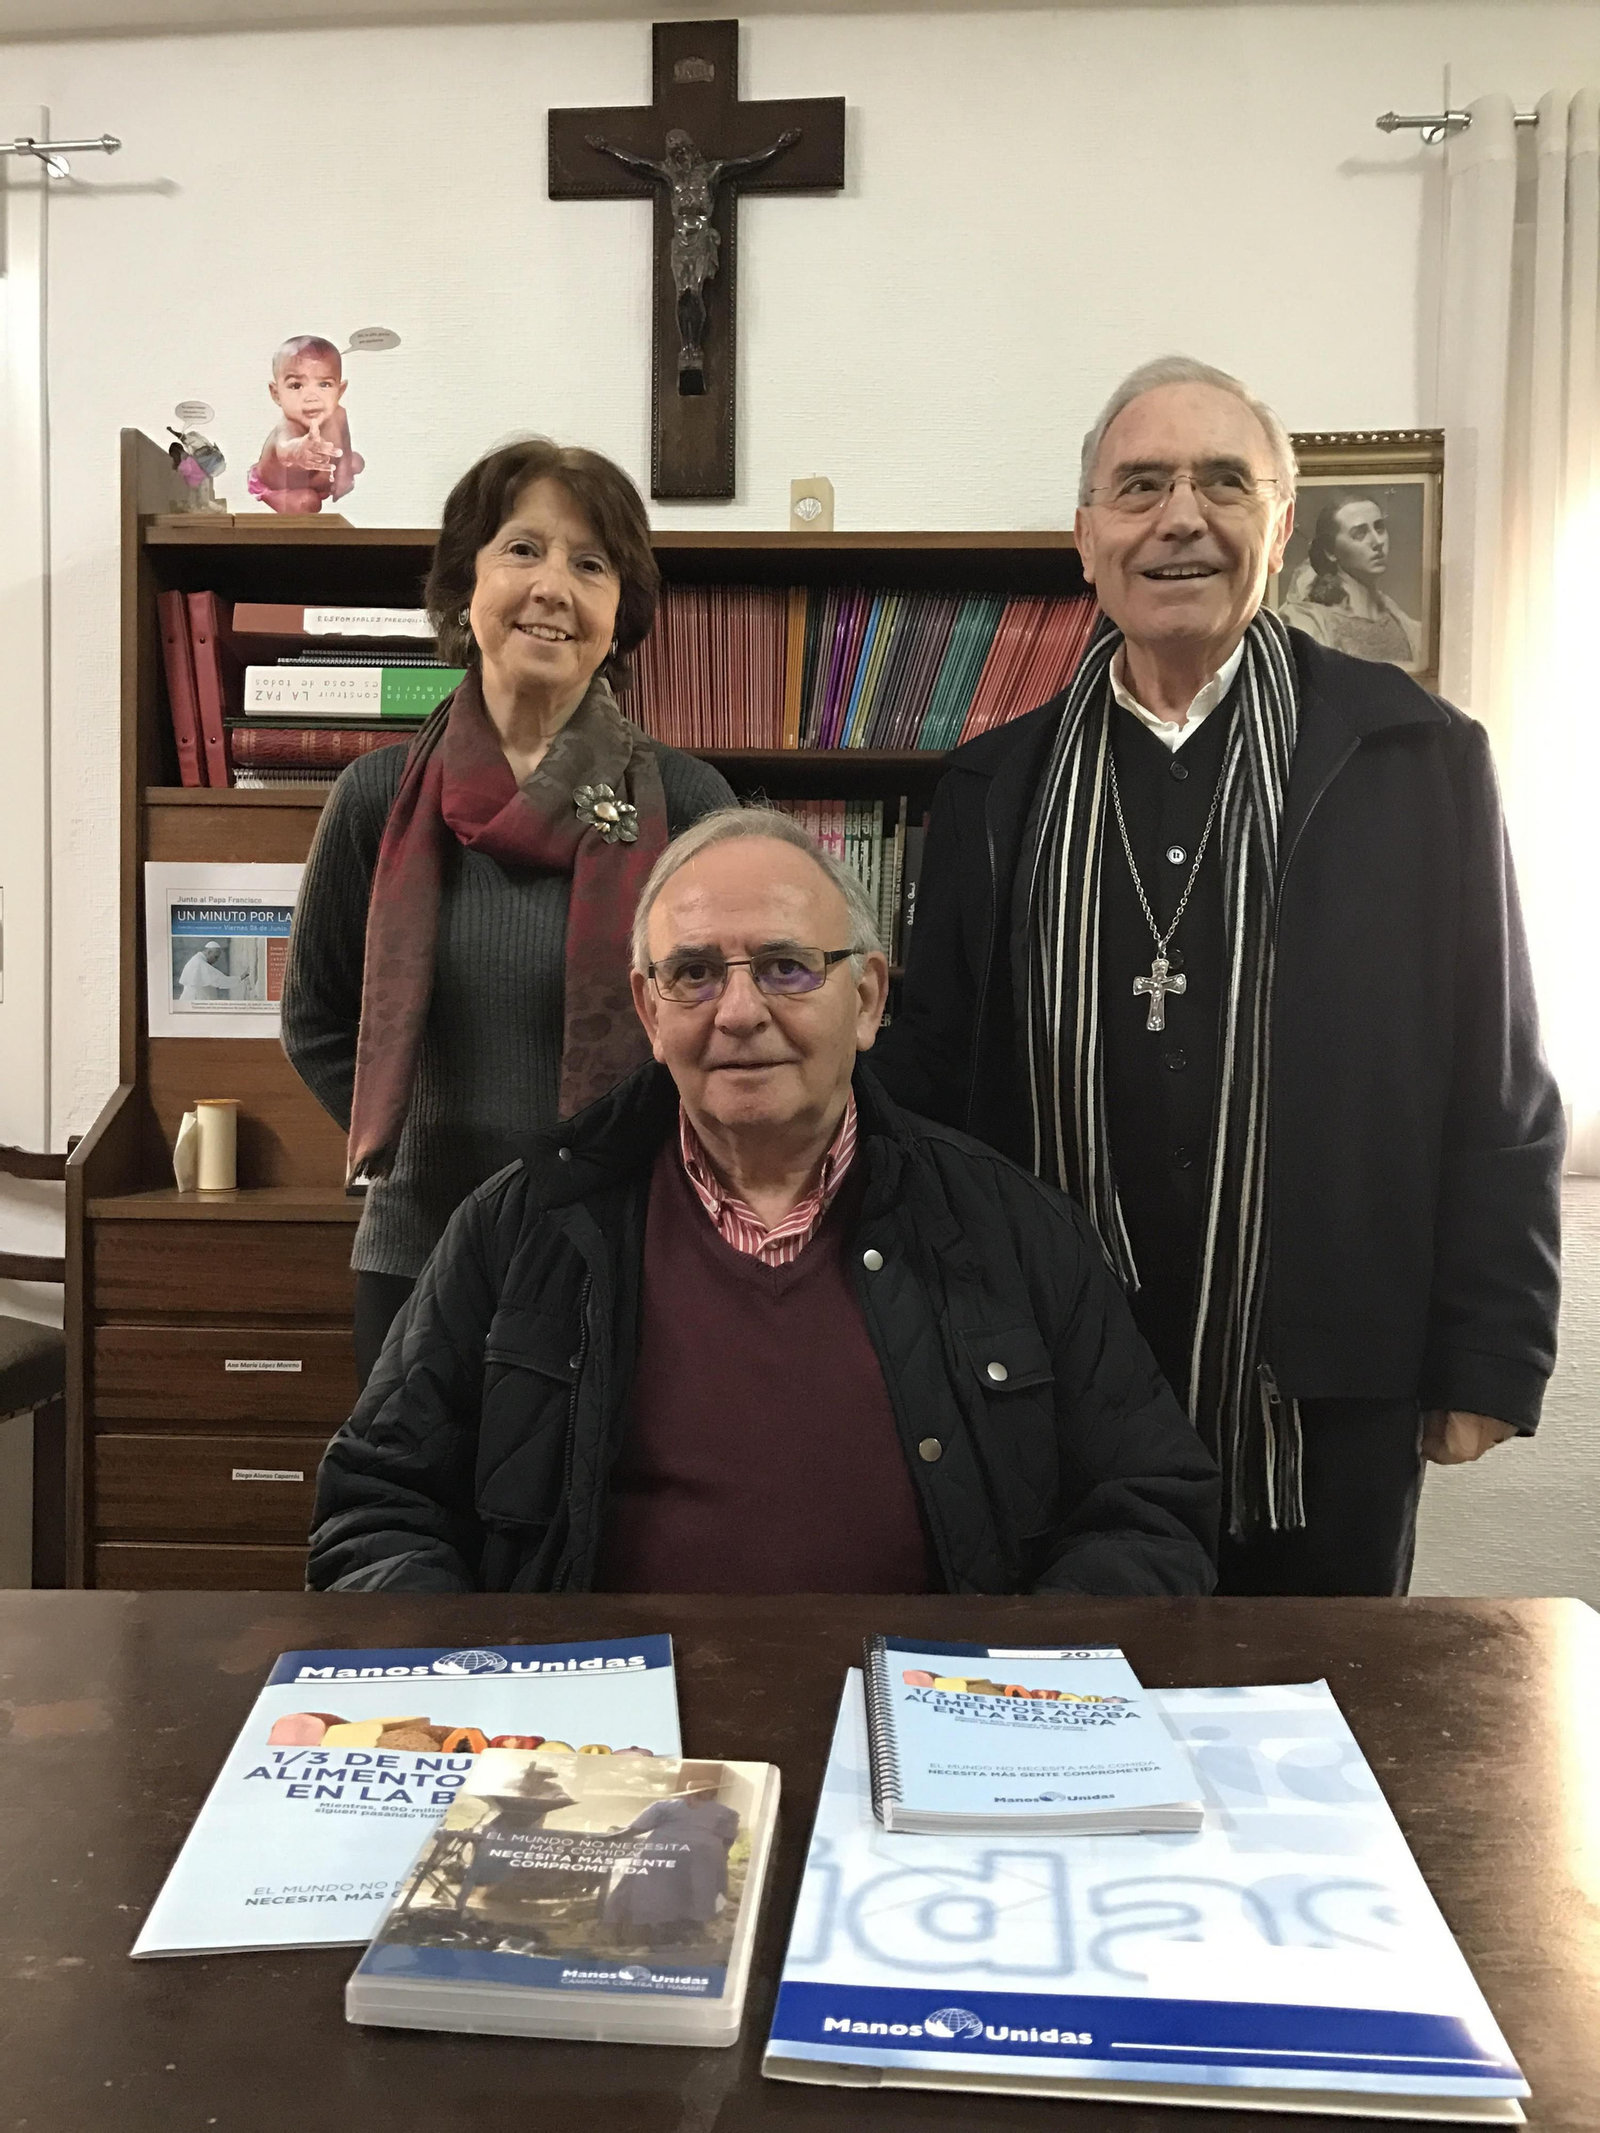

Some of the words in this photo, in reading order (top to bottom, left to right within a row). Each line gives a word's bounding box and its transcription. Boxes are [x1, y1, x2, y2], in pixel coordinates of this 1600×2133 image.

[255, 679, 291, 688] todos
[301, 679, 315, 688] de
[324, 680, 355, 688] cosa
[364, 680, 379, 689] es
[255, 690, 281, 701] PAZ
[292, 691, 309, 701] LA
[318, 692, 379, 700] construir
[208, 896, 226, 904] Papa
[177, 910, 196, 921] UN
[200, 911, 246, 922] MINUTO
[250, 912, 274, 922] POR
[278, 912, 293, 922] LA
[223, 924, 248, 932] Viernes
[298, 1665, 430, 1678] Manos
[510, 1655, 646, 1674] Unidas
[913, 1688, 947, 1699] 1/3
[955, 1693, 986, 1702] DE
[995, 1697, 1126, 1712] NUESTROS
[904, 1694, 1043, 1716] ALIMENTOS
[1055, 1708, 1142, 1719] ACABA
[933, 1706, 965, 1716] EN
[974, 1710, 1004, 1720] LA
[1013, 1714, 1117, 1727] BASURA
[272, 1750, 331, 1766] 1/3
[344, 1752, 400, 1768] DE
[415, 1758, 473, 1772] NU
[1079, 1762, 1105, 1770] MÁS
[1108, 1760, 1156, 1769] COMIDA
[243, 1766, 467, 1788] ALIMENTO
[928, 1769, 987, 1777] NECESITA
[1063, 1766, 1162, 1777] COMPROMETIDA
[286, 1784, 345, 1799] EN
[359, 1786, 414, 1804] LA
[430, 1790, 457, 1805] B
[1067, 1793, 1116, 1801] Unidas
[320, 1802, 377, 1811] Mientras,
[360, 1810, 416, 1818] pasando
[486, 1831, 506, 1841] EL
[511, 1834, 574, 1847] MUNDO
[579, 1839, 605, 1848] NO
[610, 1842, 691, 1852] NECESITA
[529, 1843, 565, 1854] MÁS
[489, 1849, 572, 1863] NECESITA
[253, 1886, 276, 1896] EL
[282, 1883, 354, 1894] MUNDO
[360, 1880, 388, 1891] NO
[245, 1894, 338, 1906] NECESITA
[344, 1890, 385, 1902] MÁS
[562, 1969, 617, 1979] Manos
[651, 1975, 709, 1985] Unidas
[824, 2017, 923, 2037] Manos
[985, 2026, 1093, 2045] Unidas
